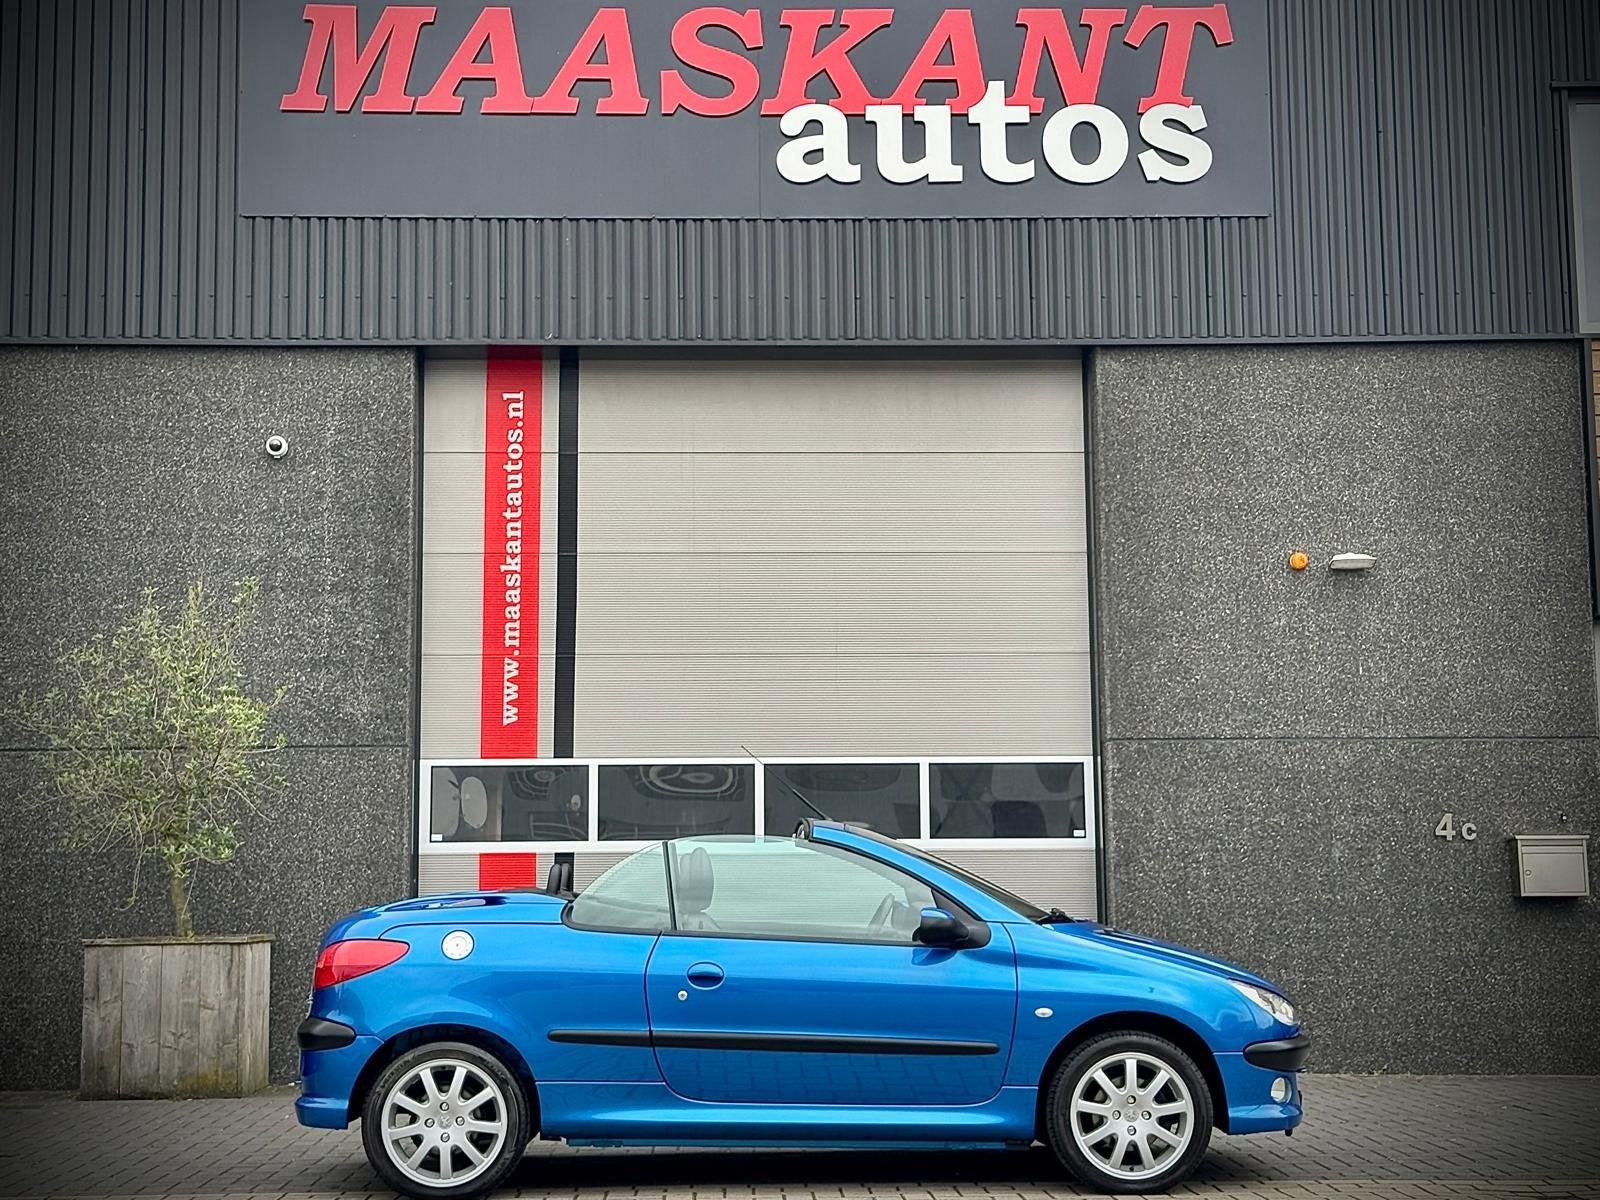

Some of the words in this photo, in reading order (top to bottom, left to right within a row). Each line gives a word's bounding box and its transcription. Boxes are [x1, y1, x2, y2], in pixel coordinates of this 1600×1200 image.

[280, 4, 1234, 116] MAASKANT
[775, 80, 1213, 183] autos
[500, 390, 525, 727] www.maaskantautos.nl
